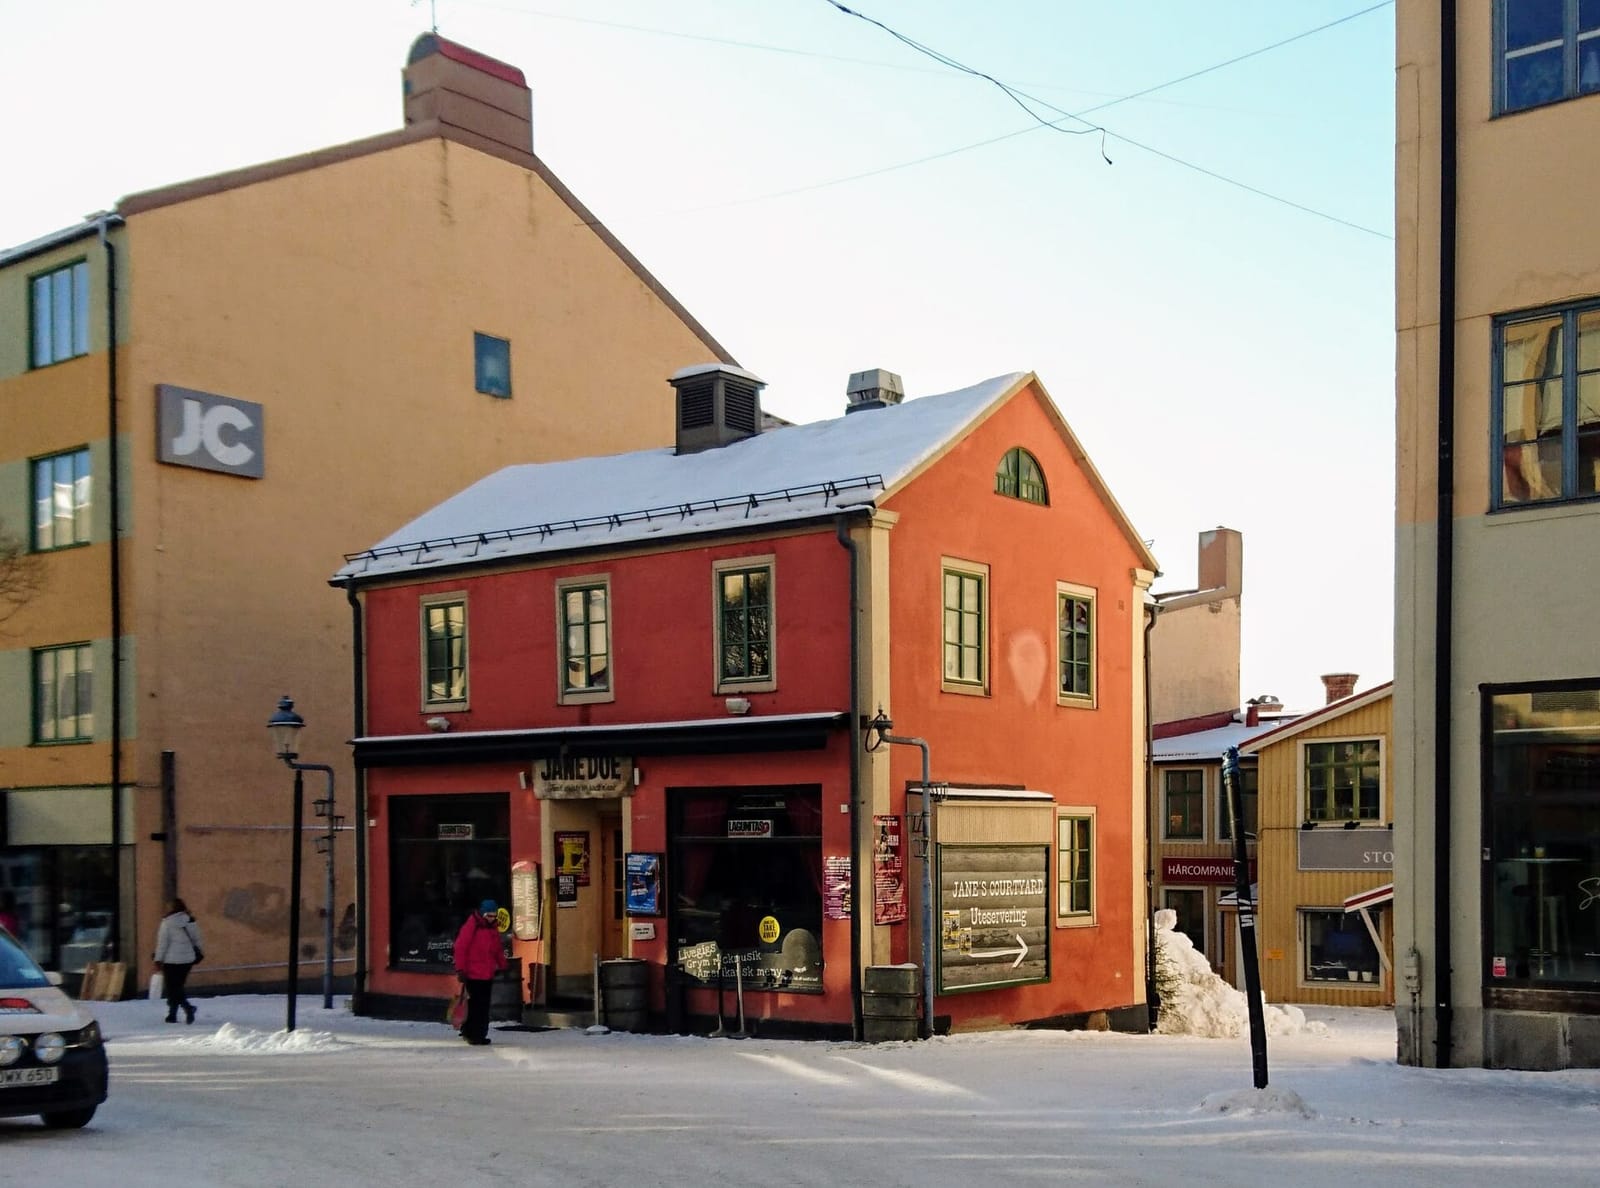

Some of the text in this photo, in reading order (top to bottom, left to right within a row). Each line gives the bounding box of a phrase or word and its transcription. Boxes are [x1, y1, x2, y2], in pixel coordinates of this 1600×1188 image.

[173, 399, 255, 466] JC
[540, 757, 622, 781] JANE DOE
[1168, 863, 1236, 877] HÅRCOMPANIE
[952, 878, 1044, 898] JANE'S COURTYARD
[970, 905, 1028, 927] Uteservering
[762, 931, 777, 939] AWAY
[678, 943, 716, 961] Livegigs
[686, 950, 762, 970] Grym rckmusik
[697, 966, 754, 978] Amerikask
[756, 967, 782, 978] meny
